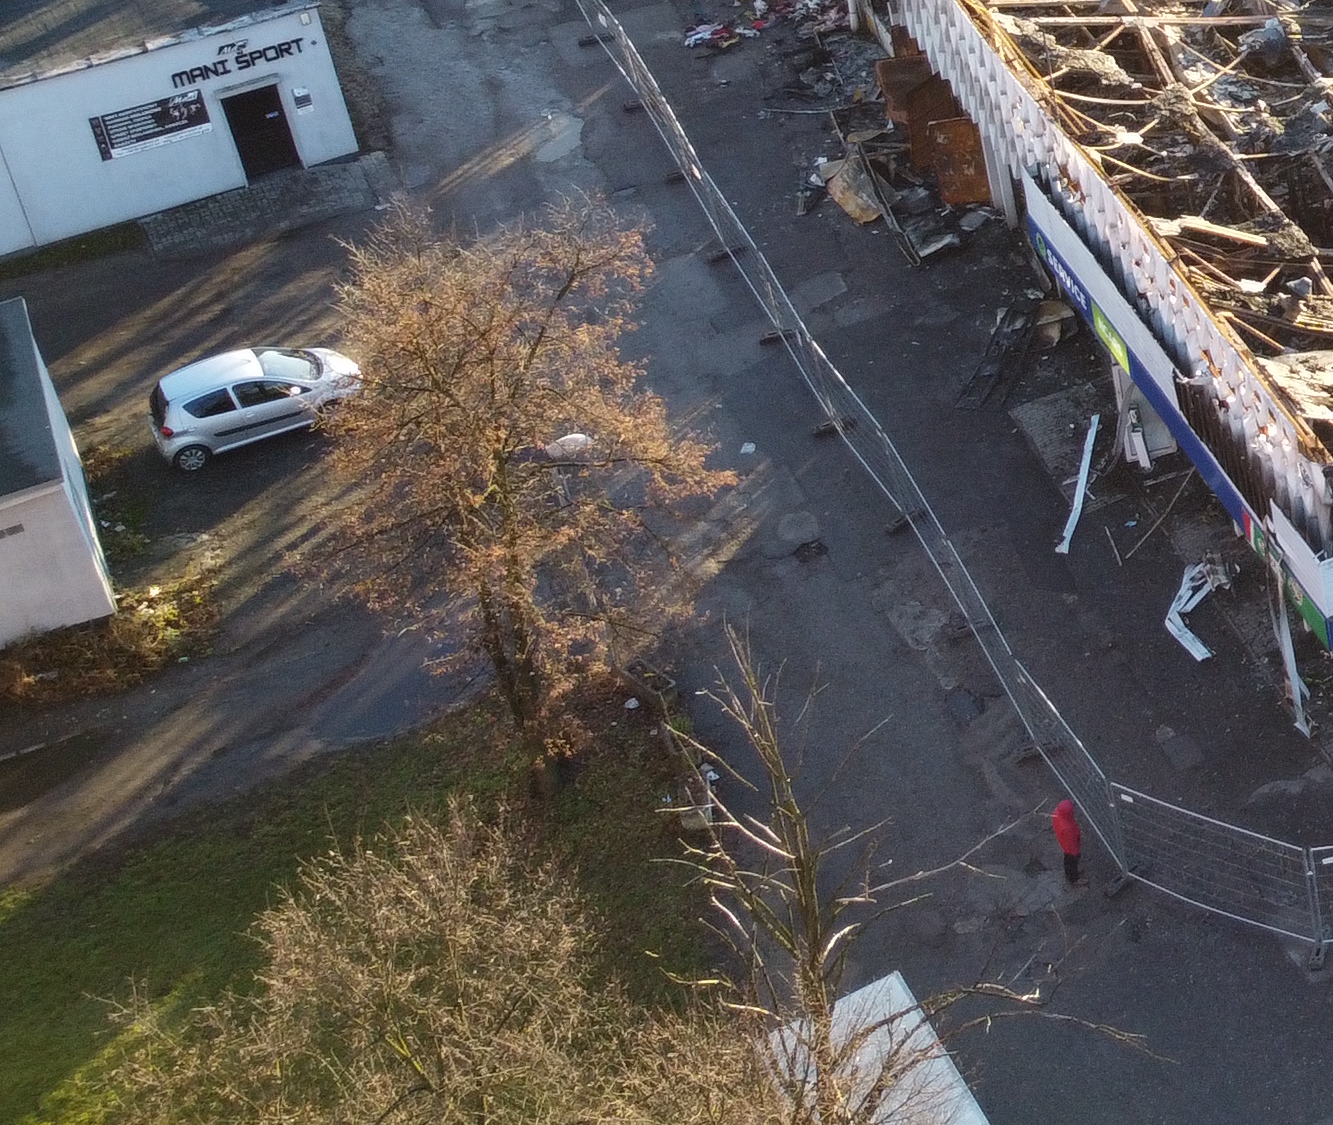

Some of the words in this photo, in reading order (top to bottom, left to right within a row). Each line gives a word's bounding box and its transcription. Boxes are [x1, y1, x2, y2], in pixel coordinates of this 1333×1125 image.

[171, 59, 232, 89] MANI
[235, 37, 304, 71] SPORT
[1046, 248, 1088, 311] SERVICE
